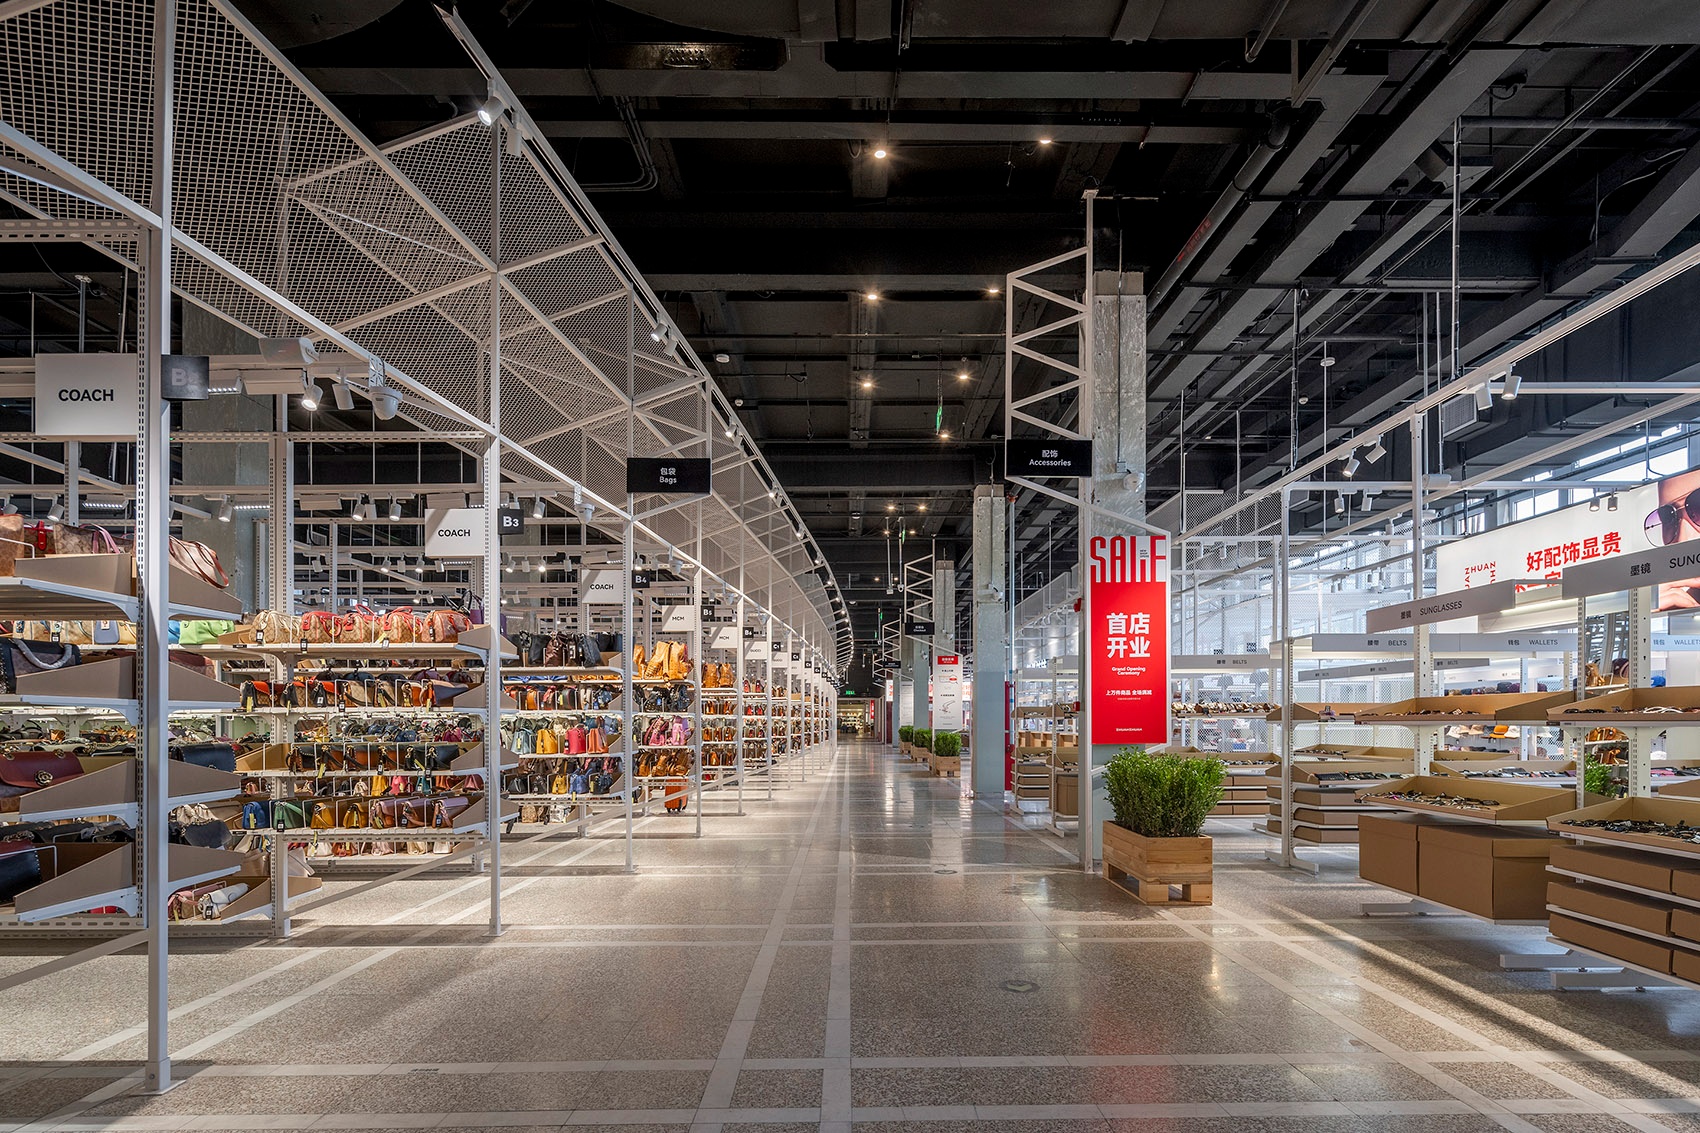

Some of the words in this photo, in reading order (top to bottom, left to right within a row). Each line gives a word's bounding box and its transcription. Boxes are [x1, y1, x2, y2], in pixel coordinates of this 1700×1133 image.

[58, 389, 114, 401] COACH
[1042, 449, 1058, 458] 配饰
[1029, 459, 1072, 467] Accessories
[659, 476, 677, 485] Bags
[503, 516, 519, 527] B3
[438, 529, 471, 537] COACH
[1526, 531, 1621, 572] 好配饰显贵
[1630, 562, 1651, 577] 墨镜
[635, 575, 647, 584] B4
[1420, 600, 1463, 616] SUNGLASSES
[1106, 612, 1151, 635] 首店
[1106, 636, 1151, 659] 开业
